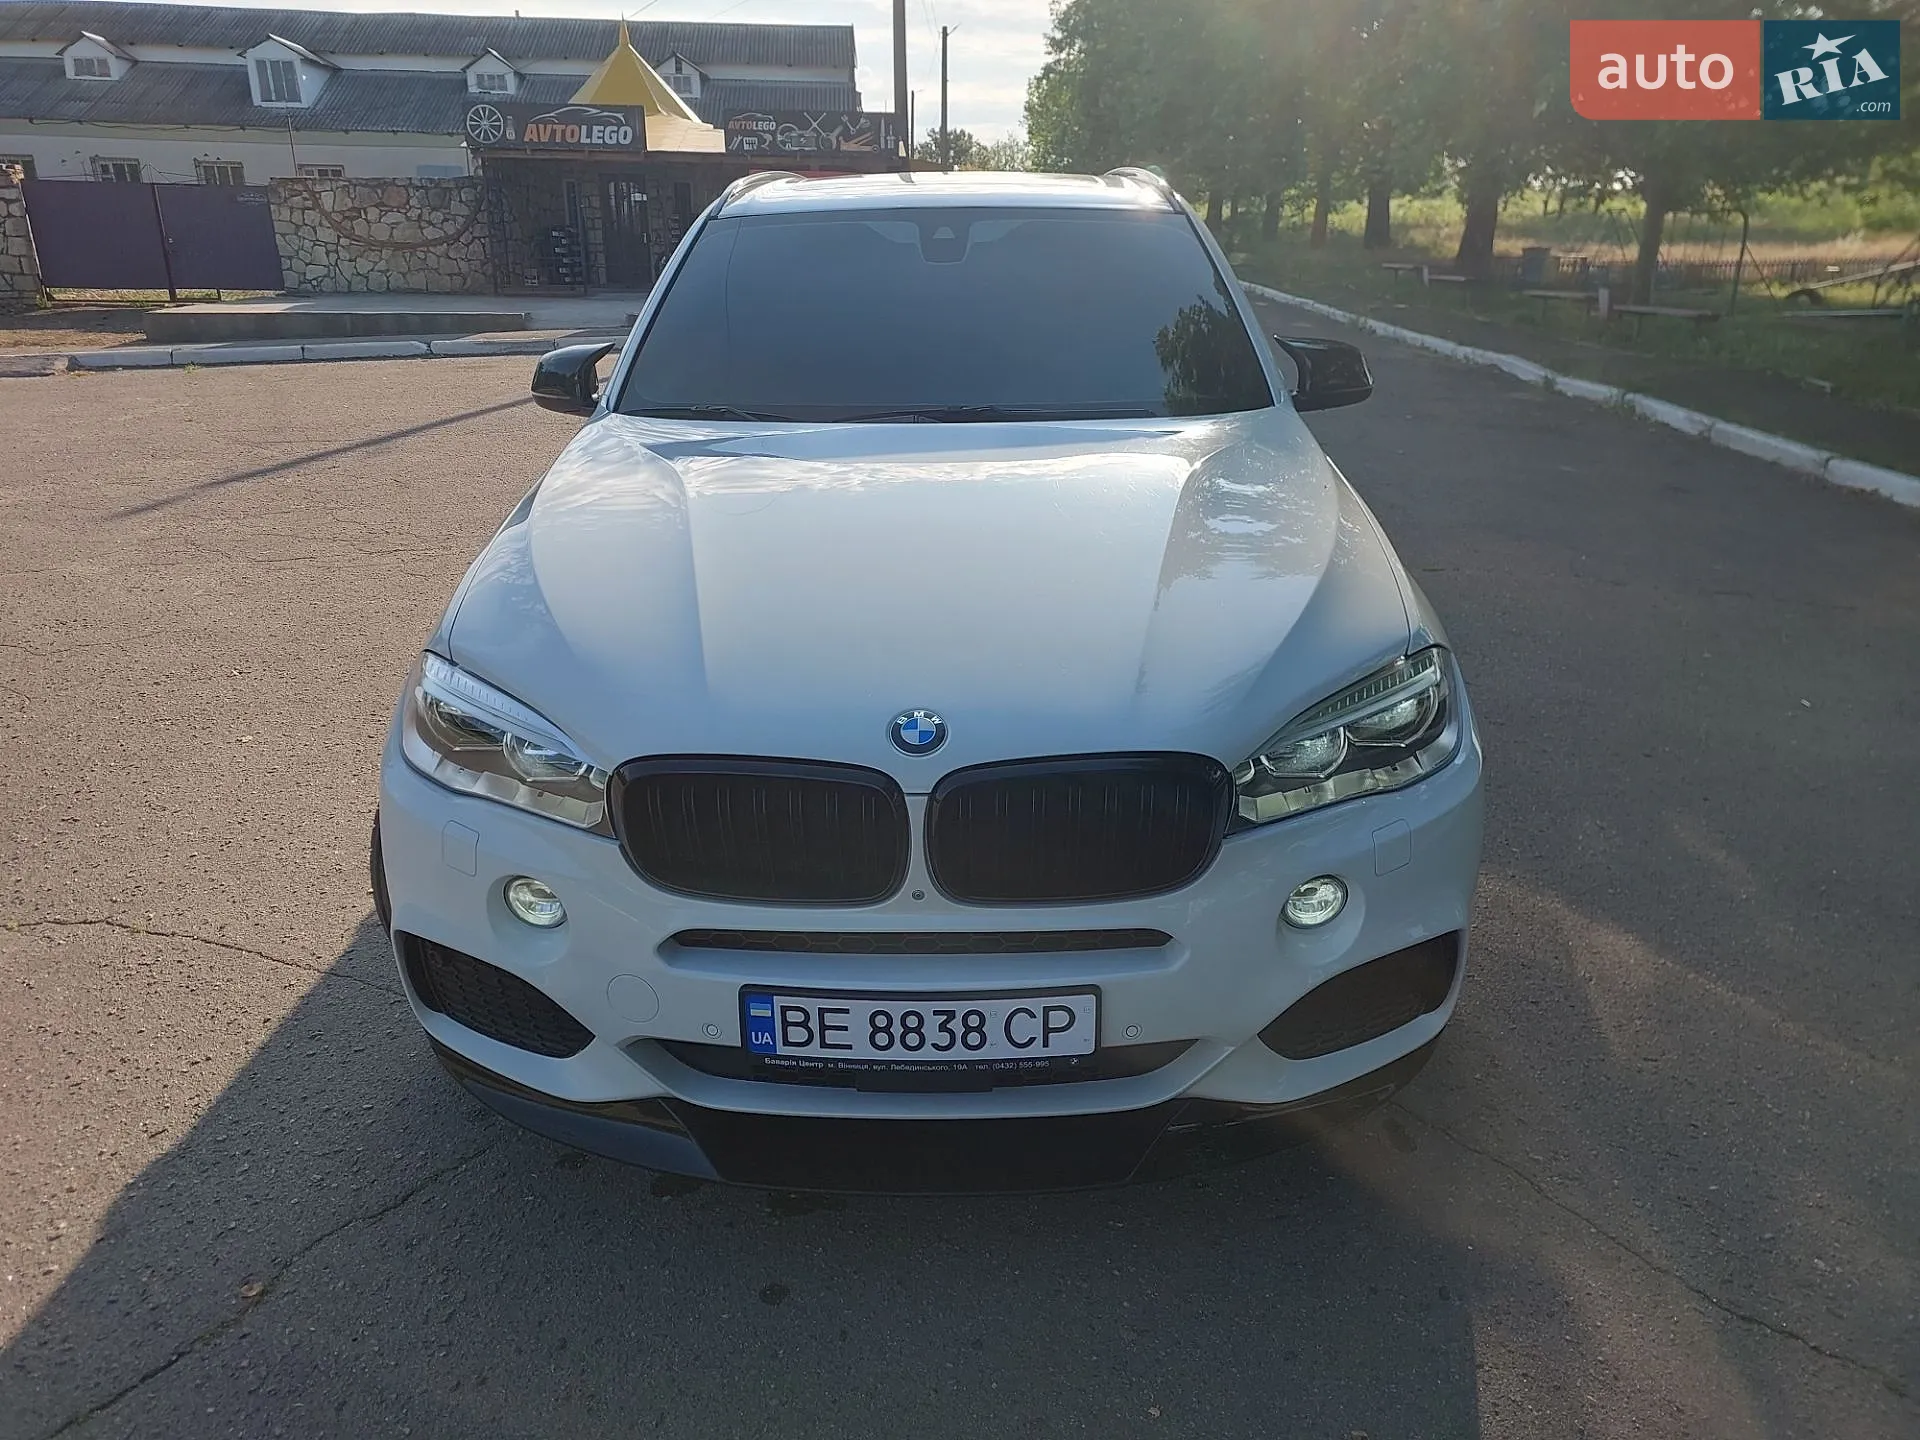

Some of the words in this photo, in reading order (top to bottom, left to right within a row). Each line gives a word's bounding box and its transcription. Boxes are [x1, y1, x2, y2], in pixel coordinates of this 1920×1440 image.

[728, 119, 776, 132] AVTOLEGO
[524, 122, 633, 146] AVTOLEGO
[897, 711, 942, 725] BMW
[779, 1005, 853, 1052] BE
[868, 1009, 988, 1053] 8838
[1003, 1005, 1076, 1050] CP
[752, 1032, 773, 1046] UA
